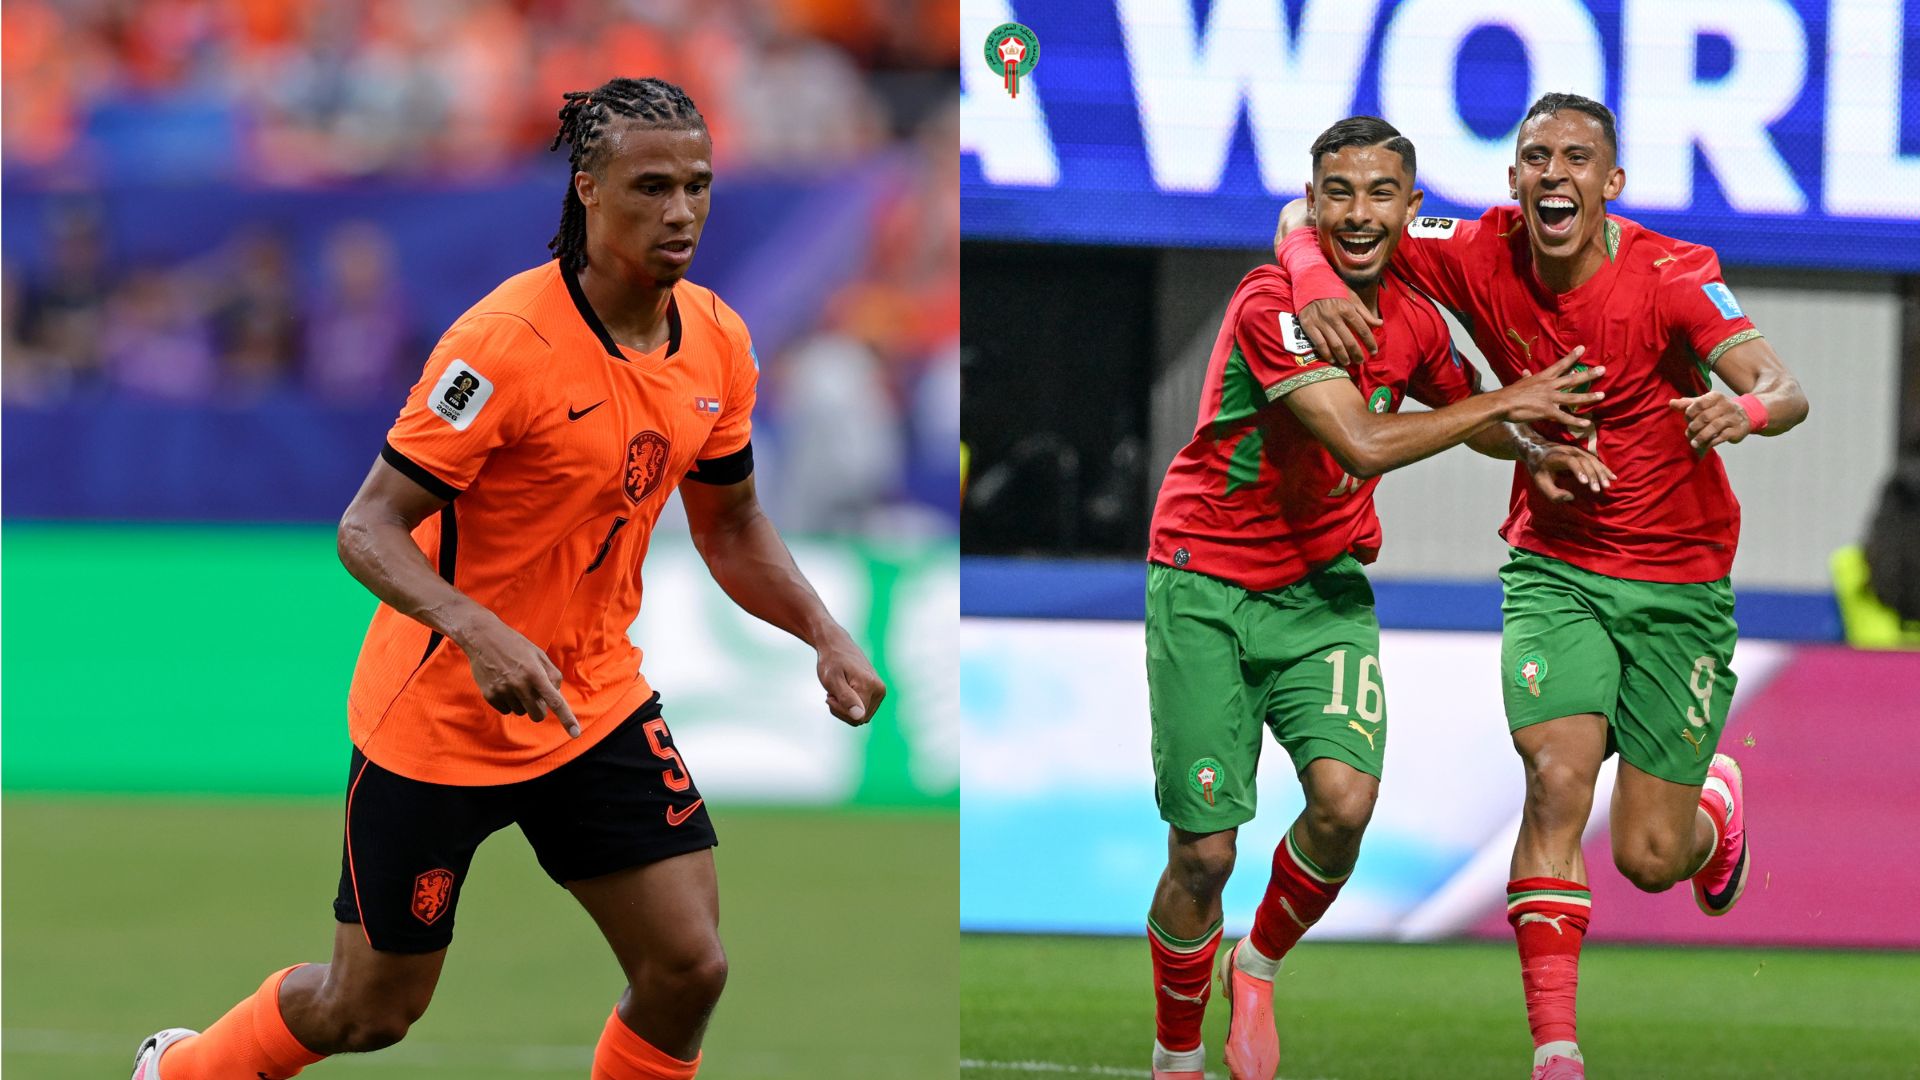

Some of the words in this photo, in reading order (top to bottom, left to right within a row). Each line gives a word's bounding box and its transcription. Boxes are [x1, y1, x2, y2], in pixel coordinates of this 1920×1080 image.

[436, 404, 458, 421] 2026
[449, 396, 460, 407] FIFA
[1322, 649, 1384, 724] 16
[1686, 655, 1717, 728] 9
[642, 717, 690, 792] 5
